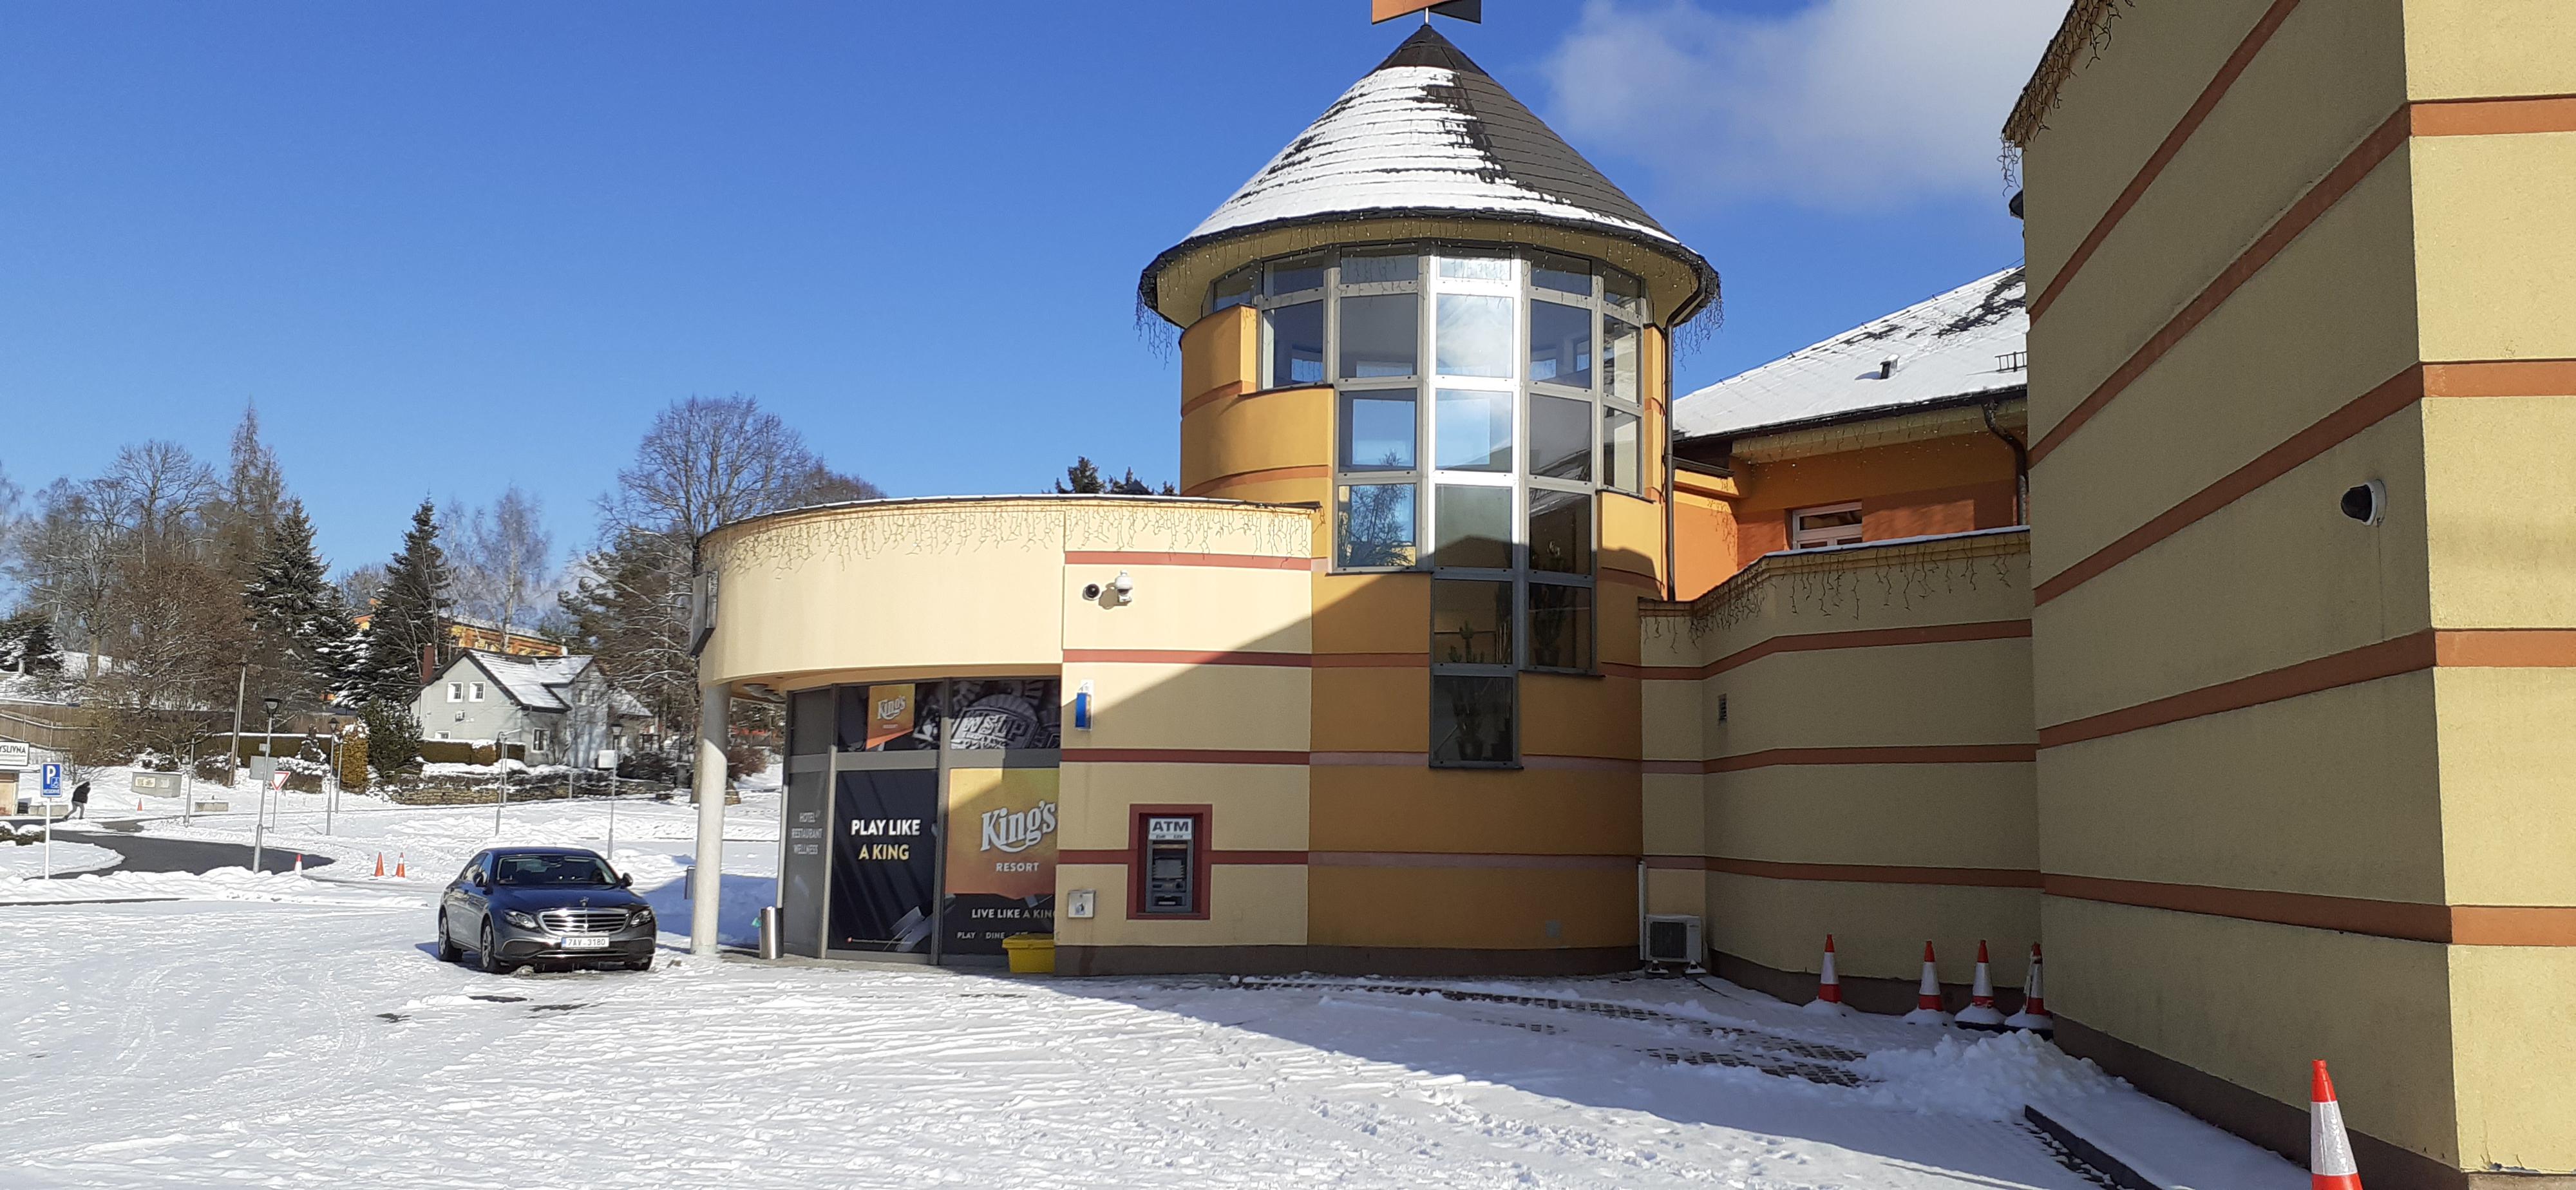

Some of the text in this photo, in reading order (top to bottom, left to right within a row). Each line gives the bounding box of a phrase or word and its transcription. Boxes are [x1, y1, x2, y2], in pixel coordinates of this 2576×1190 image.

[46, 765, 57, 784] P
[851, 819, 921, 835] PLAY LIKE
[980, 800, 1056, 853] King's
[1152, 821, 1189, 832] ATM
[858, 844, 910, 860] A KING
[996, 862, 1039, 872] RESORT
[971, 909, 1055, 918] LIVE LIKE A KIN
